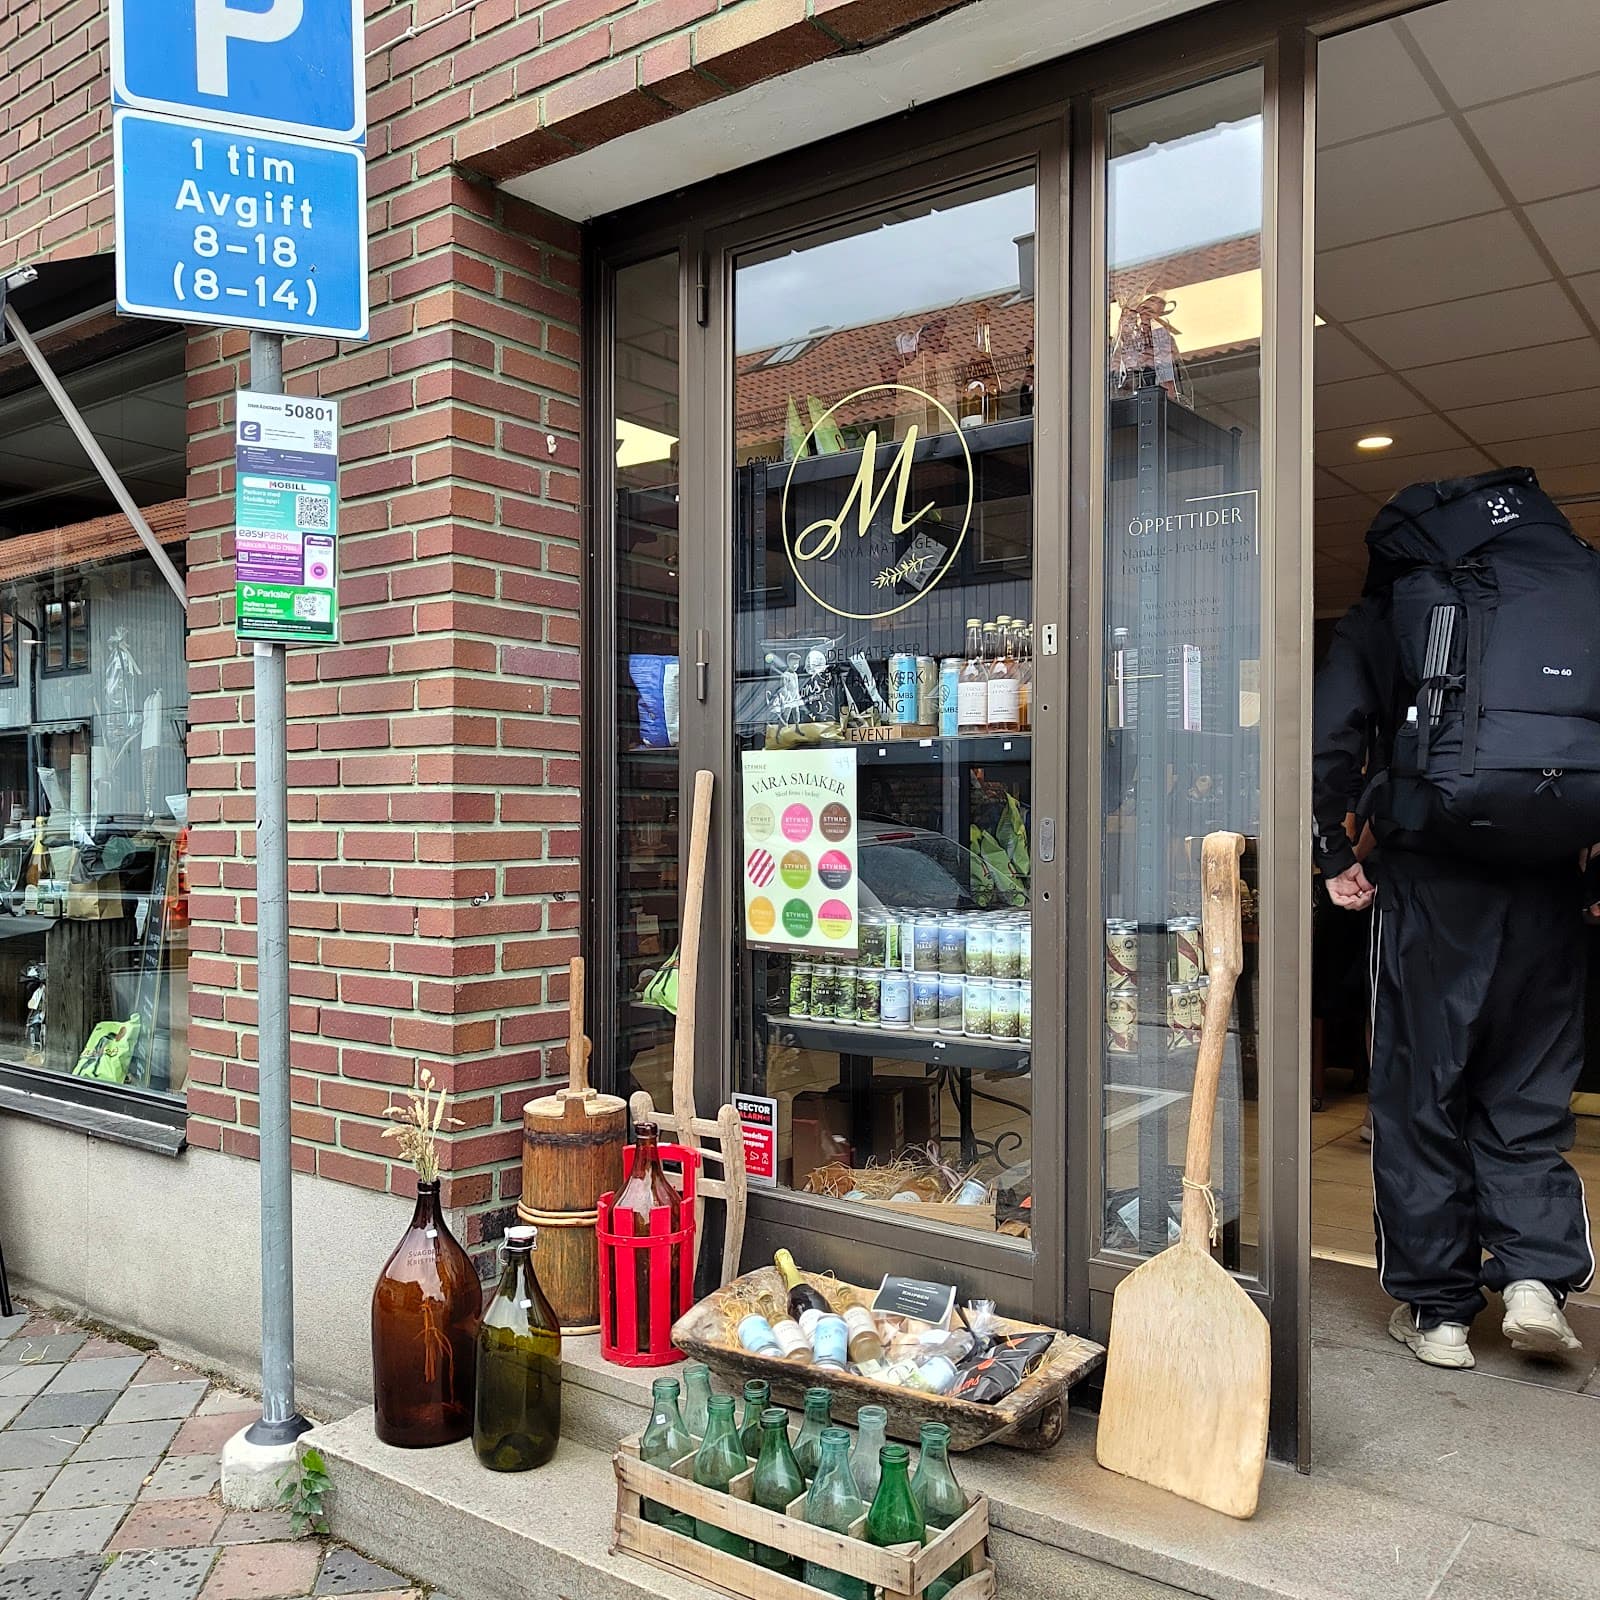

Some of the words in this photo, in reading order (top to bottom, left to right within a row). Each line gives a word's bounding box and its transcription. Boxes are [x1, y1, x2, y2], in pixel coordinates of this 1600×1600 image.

[194, 0, 304, 97] P
[191, 138, 204, 170] 1
[227, 144, 295, 185] tim
[175, 179, 313, 229] Avgift
[284, 403, 333, 422] 50801
[269, 481, 307, 491] MOBILL
[794, 424, 936, 561] M
[1128, 507, 1243, 537] ÖPPETTIDER
[1561, 668, 1572, 676] 60
[840, 700, 904, 716] CARING
[851, 727, 893, 742] EVENT
[790, 772, 846, 797] SMAKER
[738, 1102, 771, 1114] SECTOR
